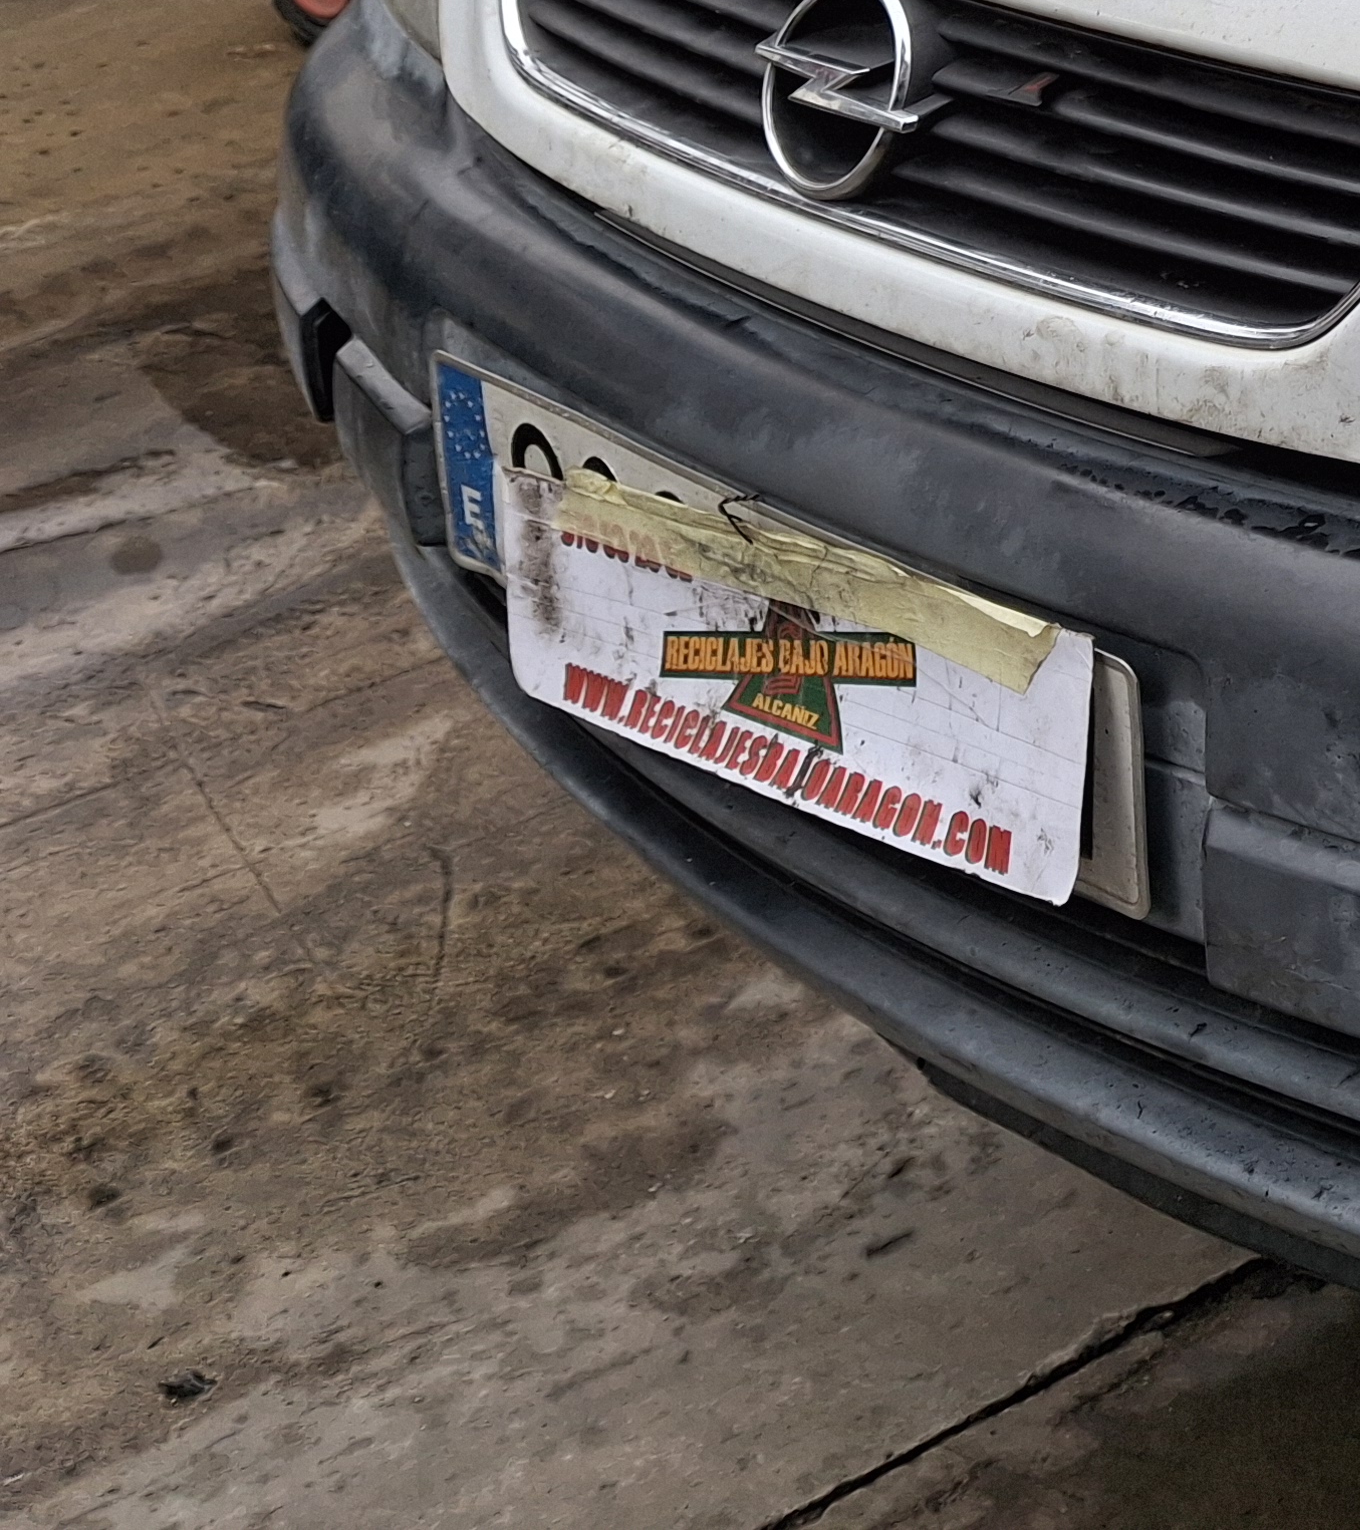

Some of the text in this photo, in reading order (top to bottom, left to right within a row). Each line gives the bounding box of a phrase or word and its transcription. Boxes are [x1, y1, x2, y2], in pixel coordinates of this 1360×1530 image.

[460, 482, 484, 531] E
[664, 635, 776, 676] RECICLAJES
[778, 638, 830, 678] BAJO
